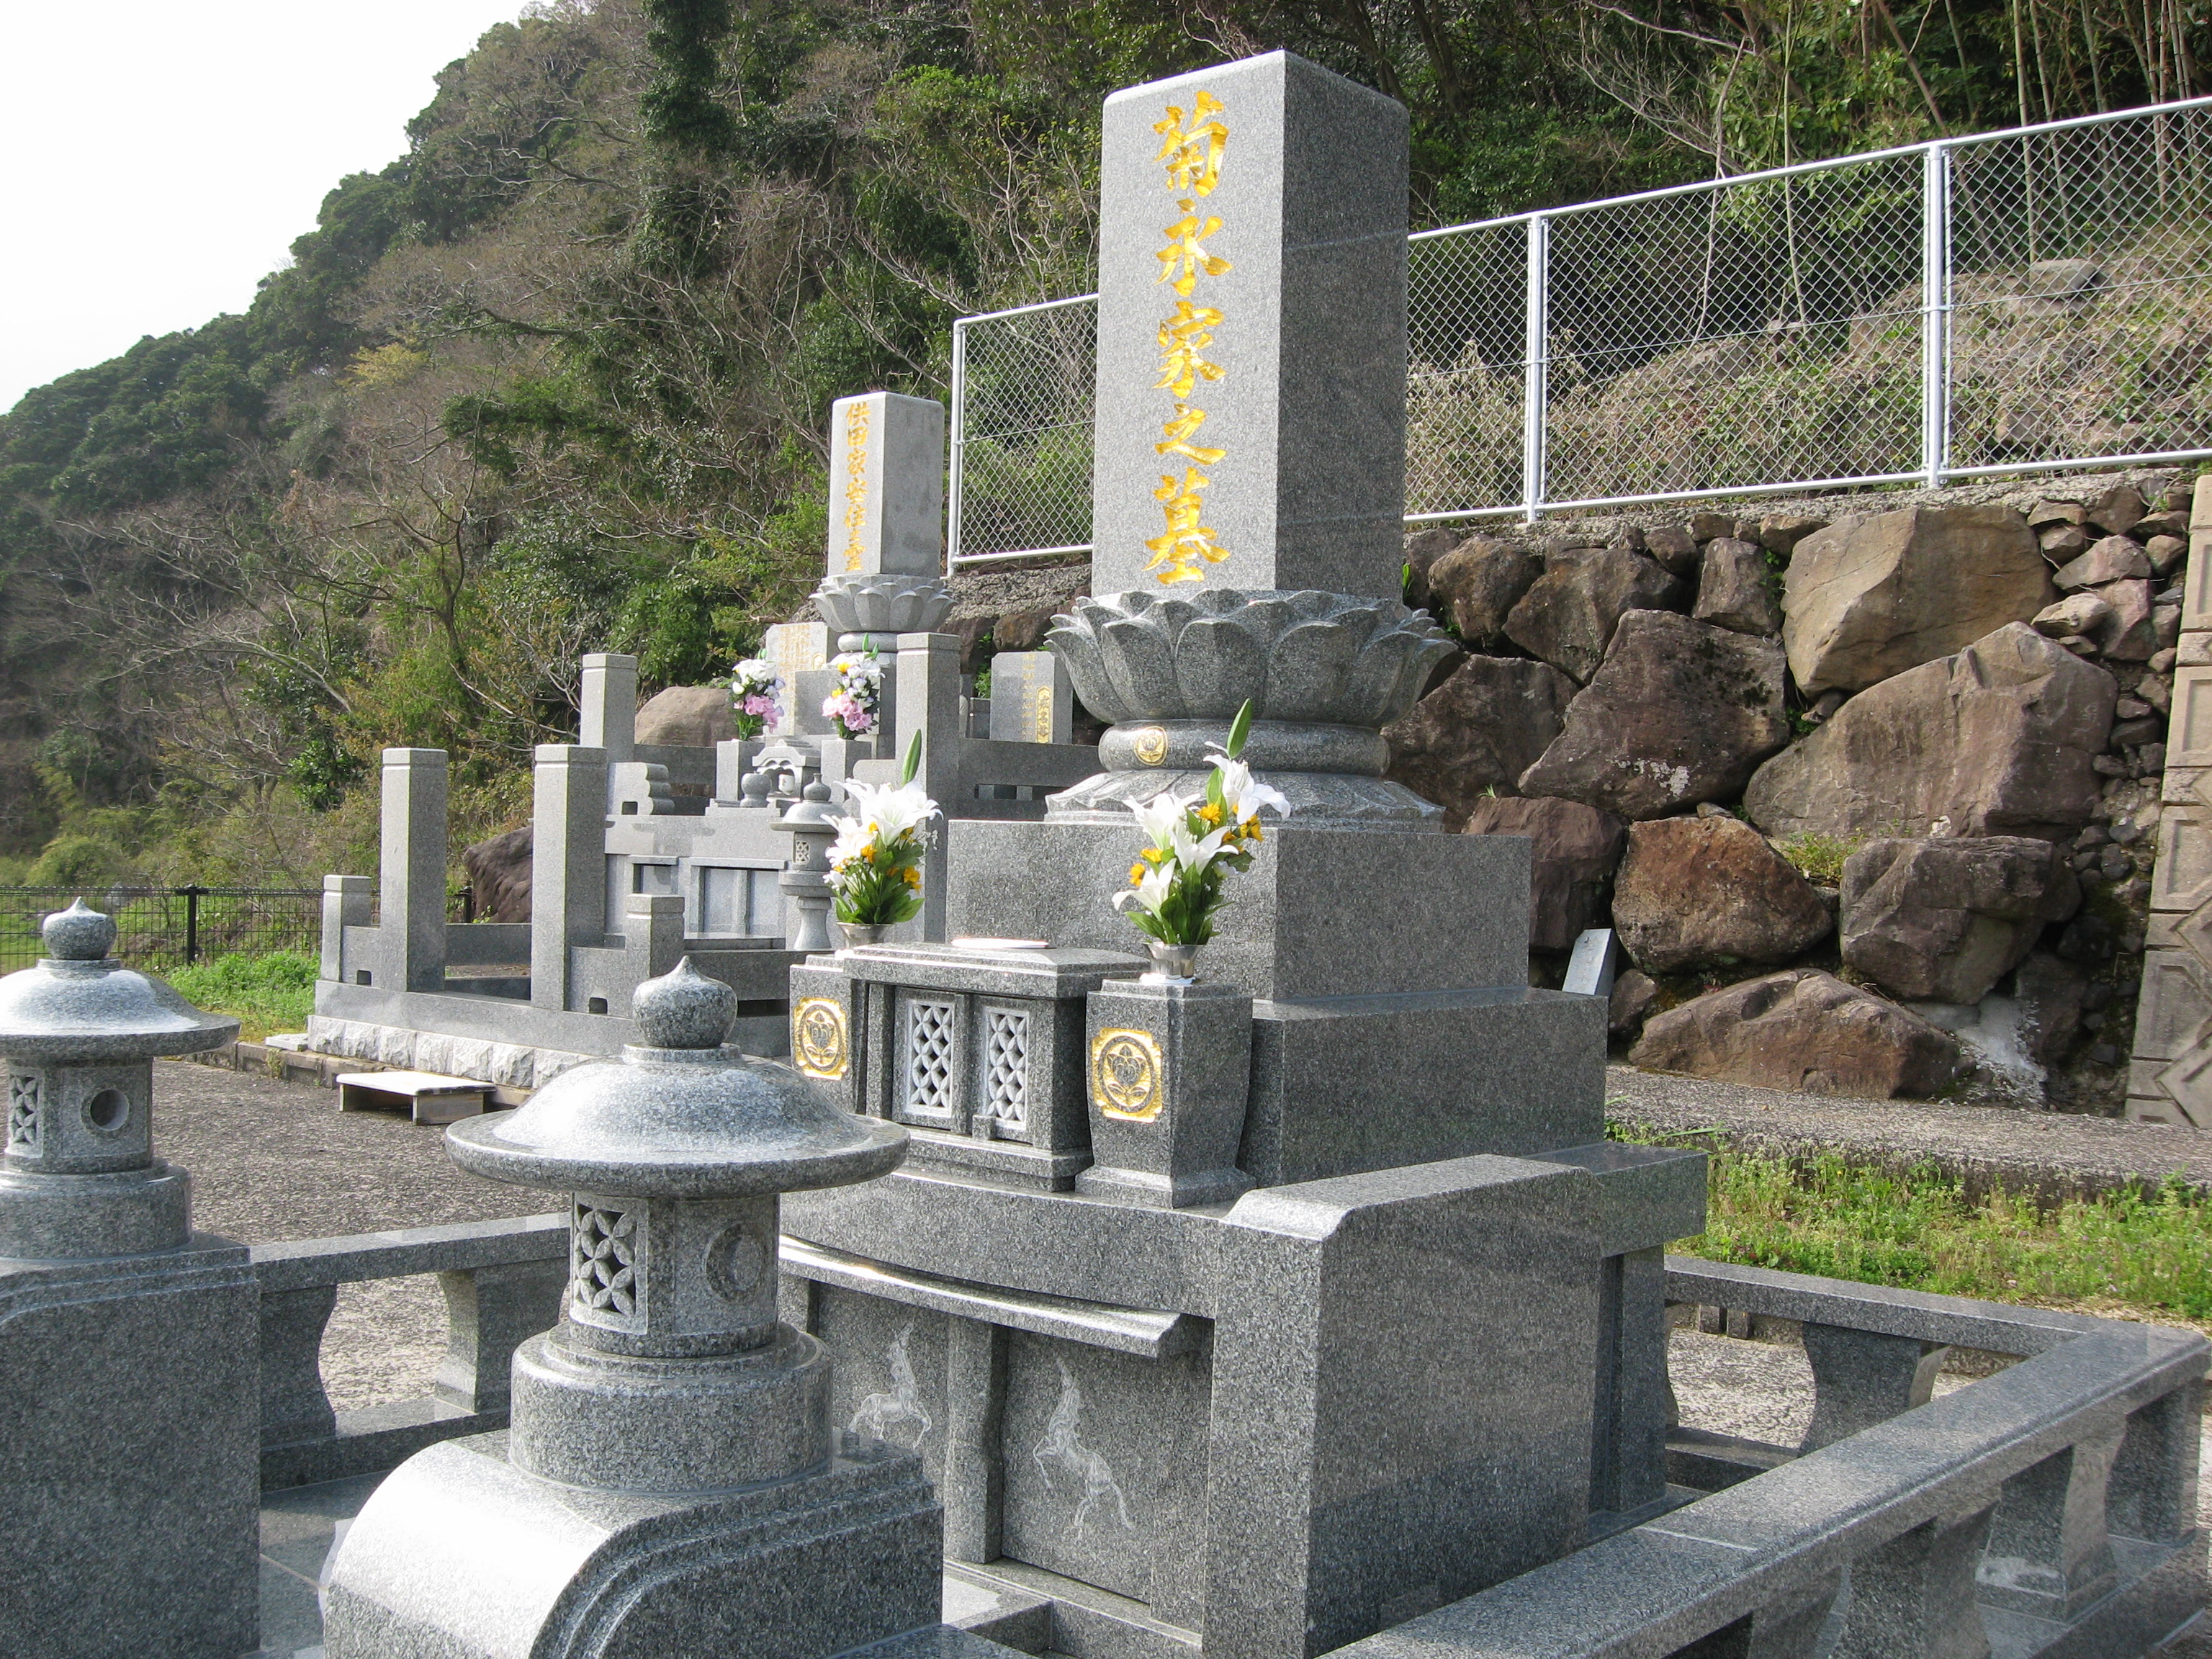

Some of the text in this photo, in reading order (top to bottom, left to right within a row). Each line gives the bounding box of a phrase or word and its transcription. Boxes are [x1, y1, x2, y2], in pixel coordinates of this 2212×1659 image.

[1143, 91, 1232, 585] 菊永家之墓
